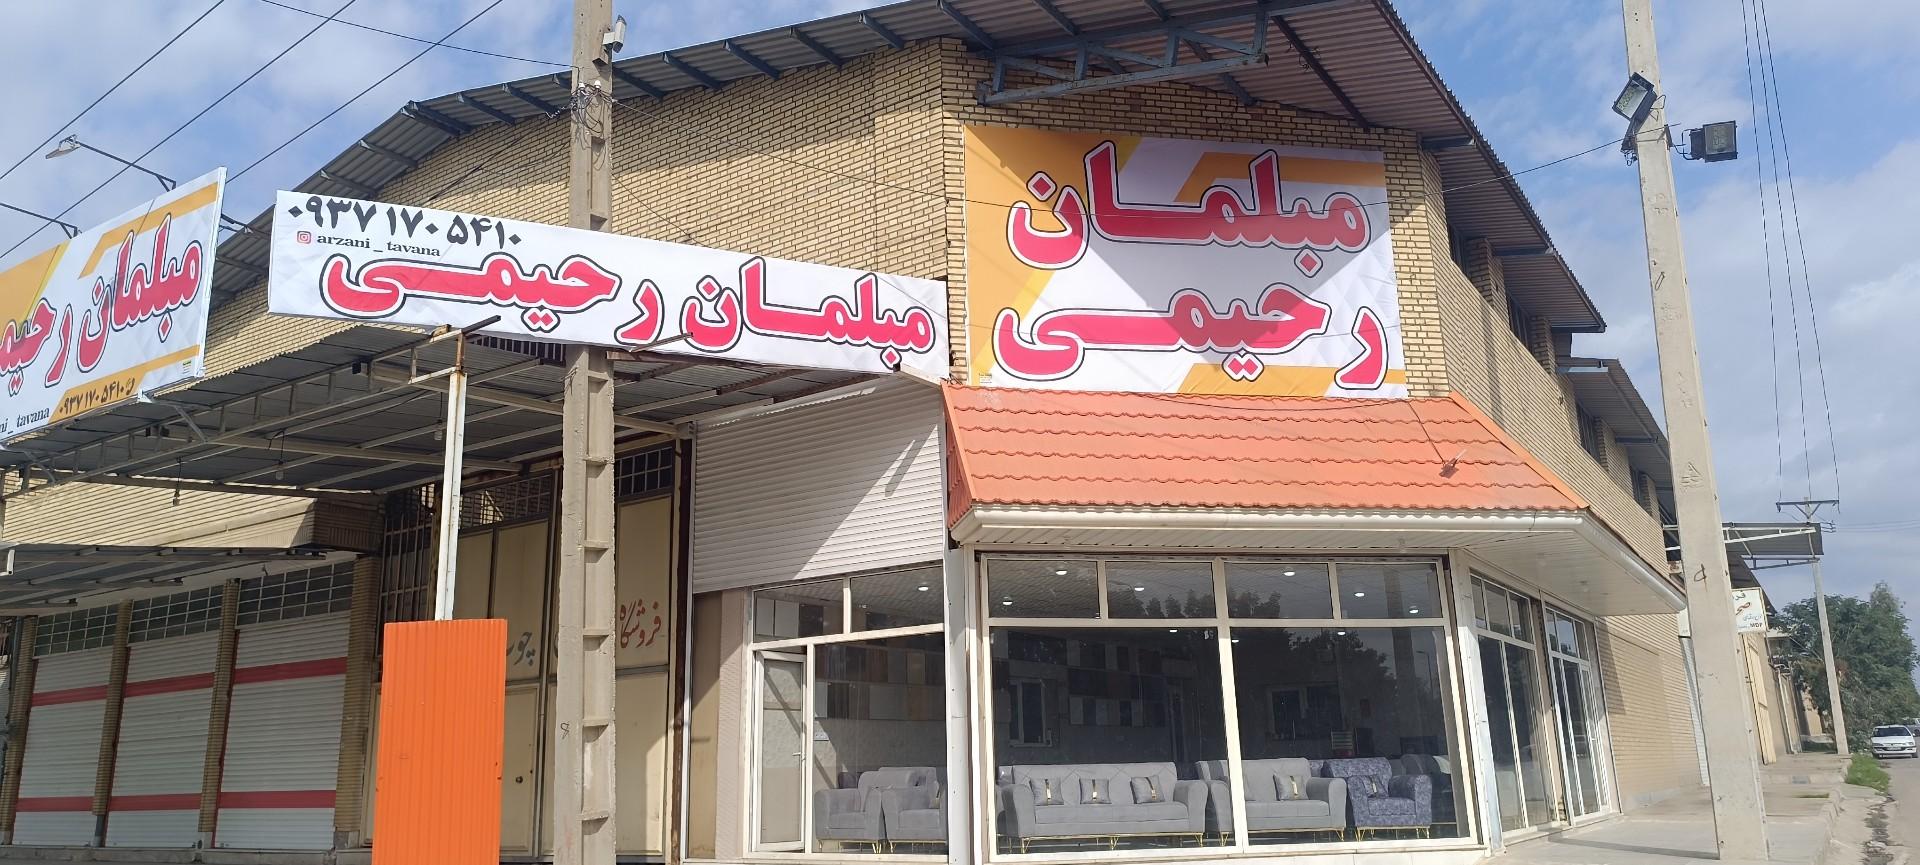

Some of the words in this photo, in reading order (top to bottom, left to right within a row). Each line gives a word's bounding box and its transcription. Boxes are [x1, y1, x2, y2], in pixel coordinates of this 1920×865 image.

[1006, 140, 1371, 278] مبلمان
[0, 297, 73, 397] رحیم
[77, 212, 203, 373] مبلمان
[319, 252, 665, 346] رحیمی
[679, 256, 936, 369] مبلمان
[992, 282, 1389, 391] رحیمی
[619, 598, 662, 649] فروشگاه
